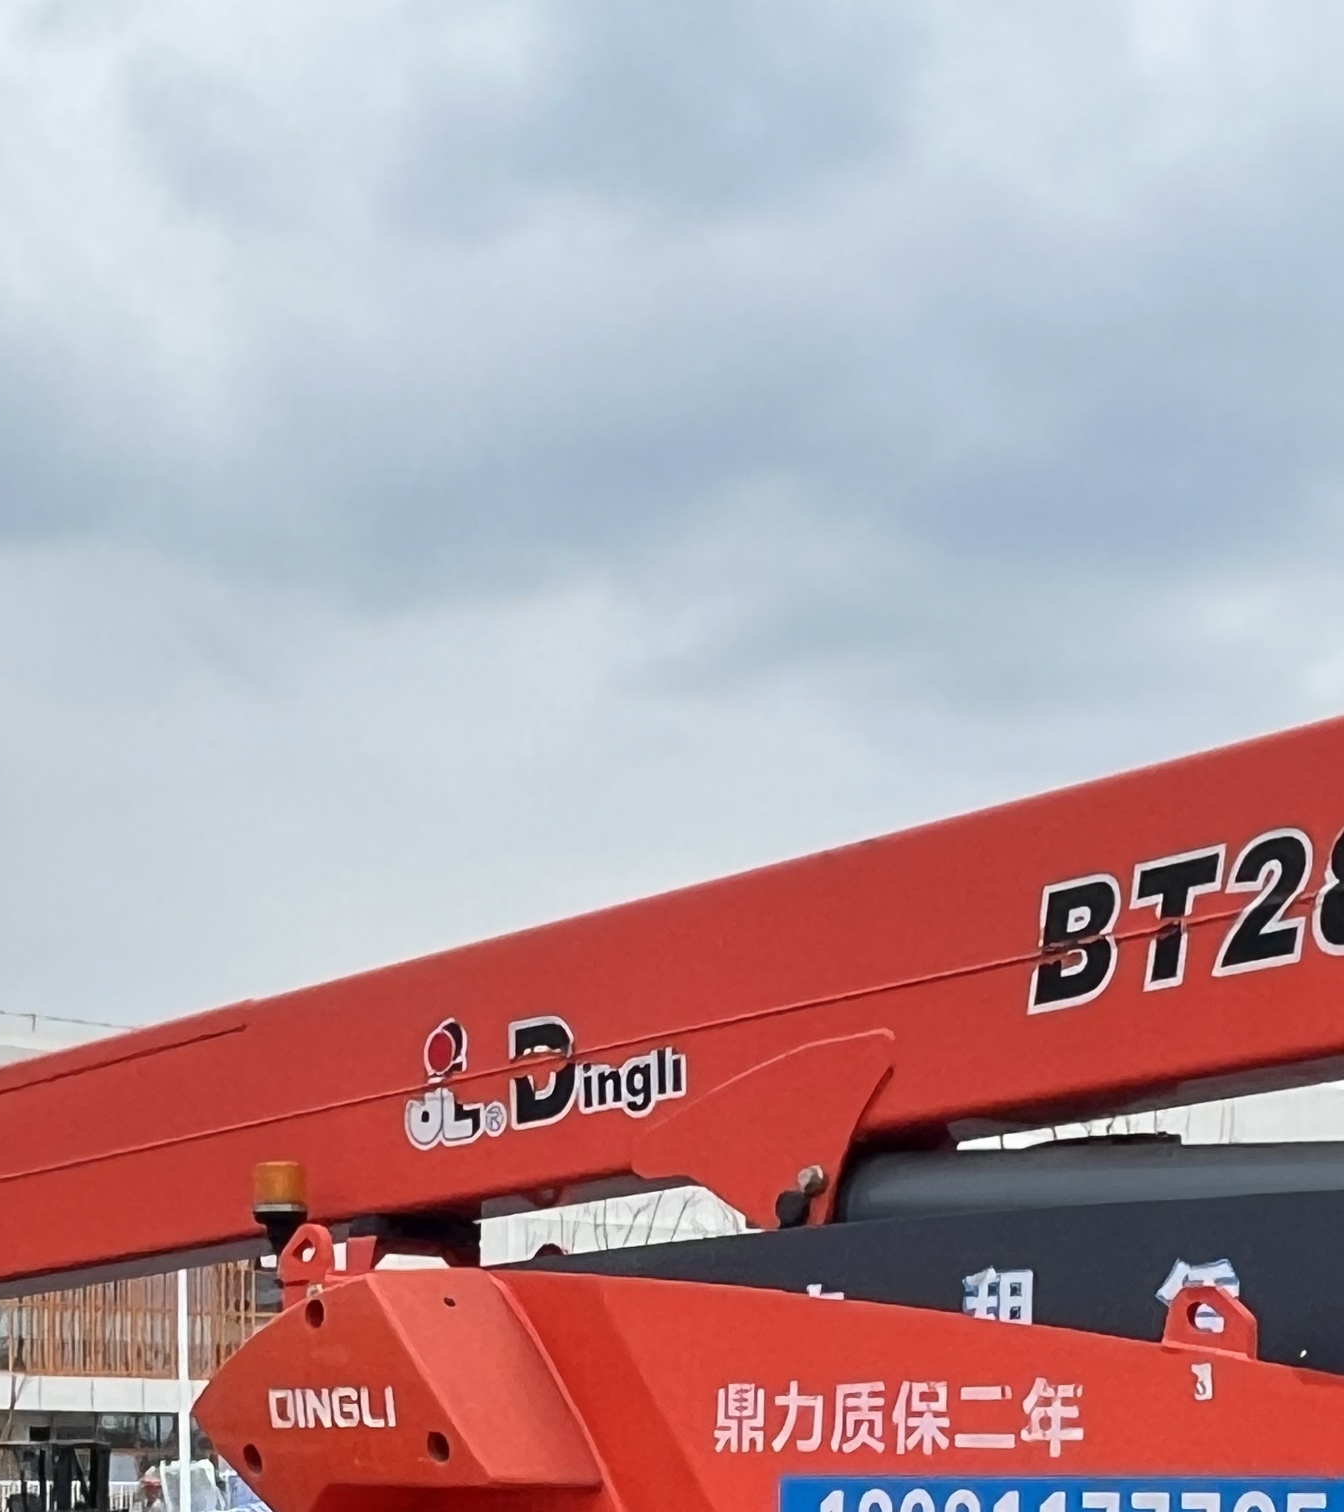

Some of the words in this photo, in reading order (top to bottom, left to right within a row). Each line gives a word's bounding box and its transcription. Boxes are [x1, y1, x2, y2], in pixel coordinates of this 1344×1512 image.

[508, 1014, 686, 1131] Dingli
[268, 1385, 397, 1429] DINGLI
[714, 1377, 1085, 1457] 鼎力质保二年
